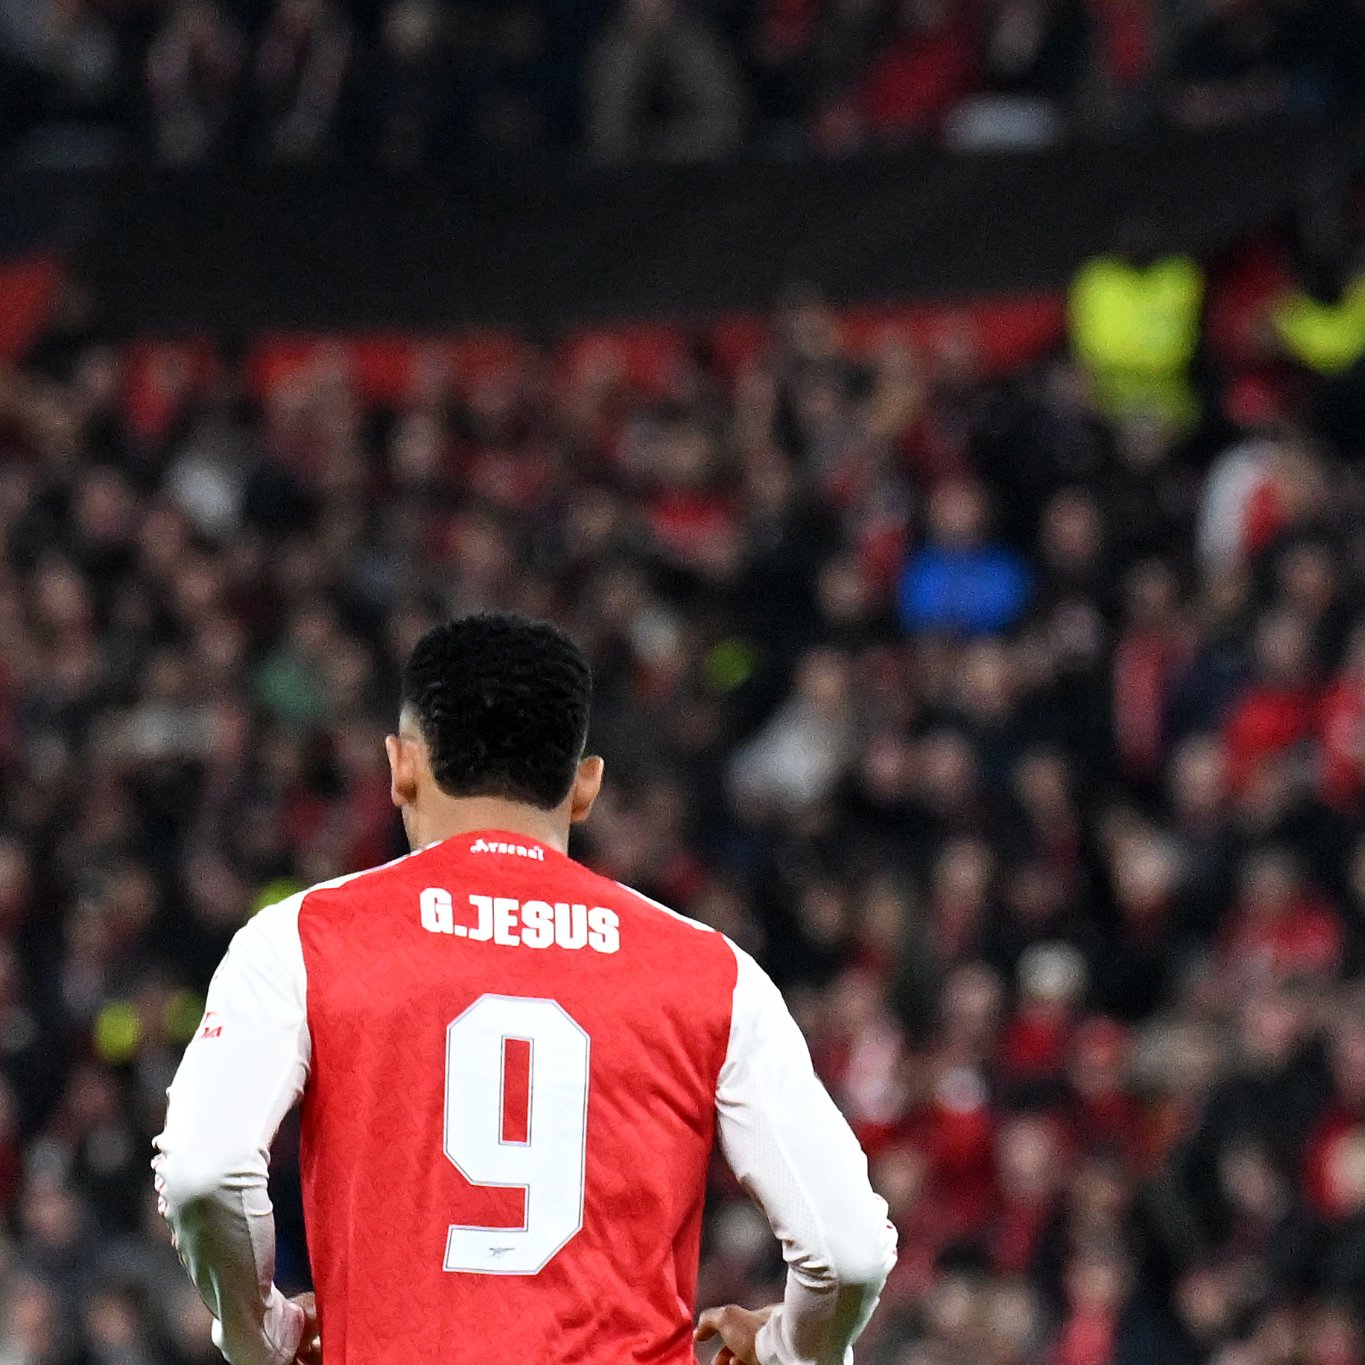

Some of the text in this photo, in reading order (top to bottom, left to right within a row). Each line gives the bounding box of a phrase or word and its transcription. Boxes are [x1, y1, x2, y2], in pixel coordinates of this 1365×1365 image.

[470, 838, 544, 861] Arsenal
[419, 887, 620, 954] G.JESUS
[443, 993, 590, 1276] 9
